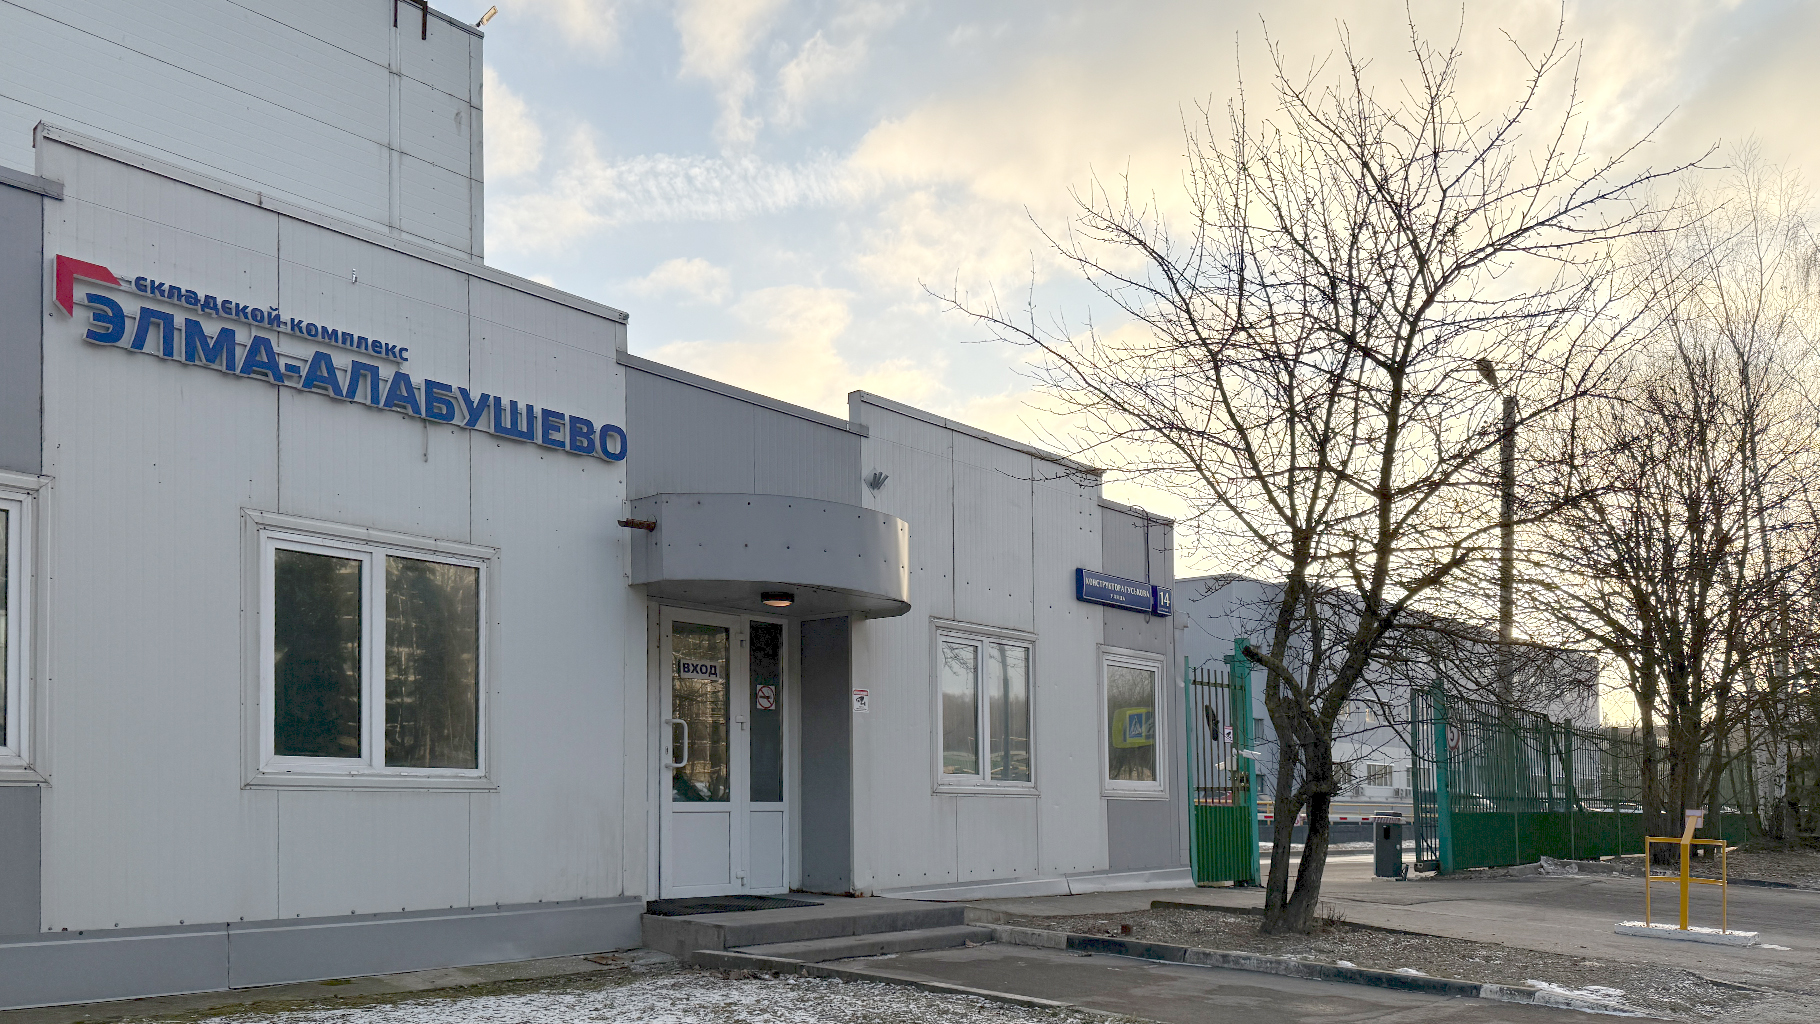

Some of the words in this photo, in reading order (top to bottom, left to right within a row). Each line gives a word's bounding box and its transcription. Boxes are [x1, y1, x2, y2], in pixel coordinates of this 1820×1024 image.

[134, 276, 281, 328] складской
[290, 317, 409, 362] комплекс
[84, 292, 628, 462] ЭЛМА-АЛАБУШЕВО
[1160, 591, 1170, 607] 14
[682, 662, 718, 678] ВХОД
